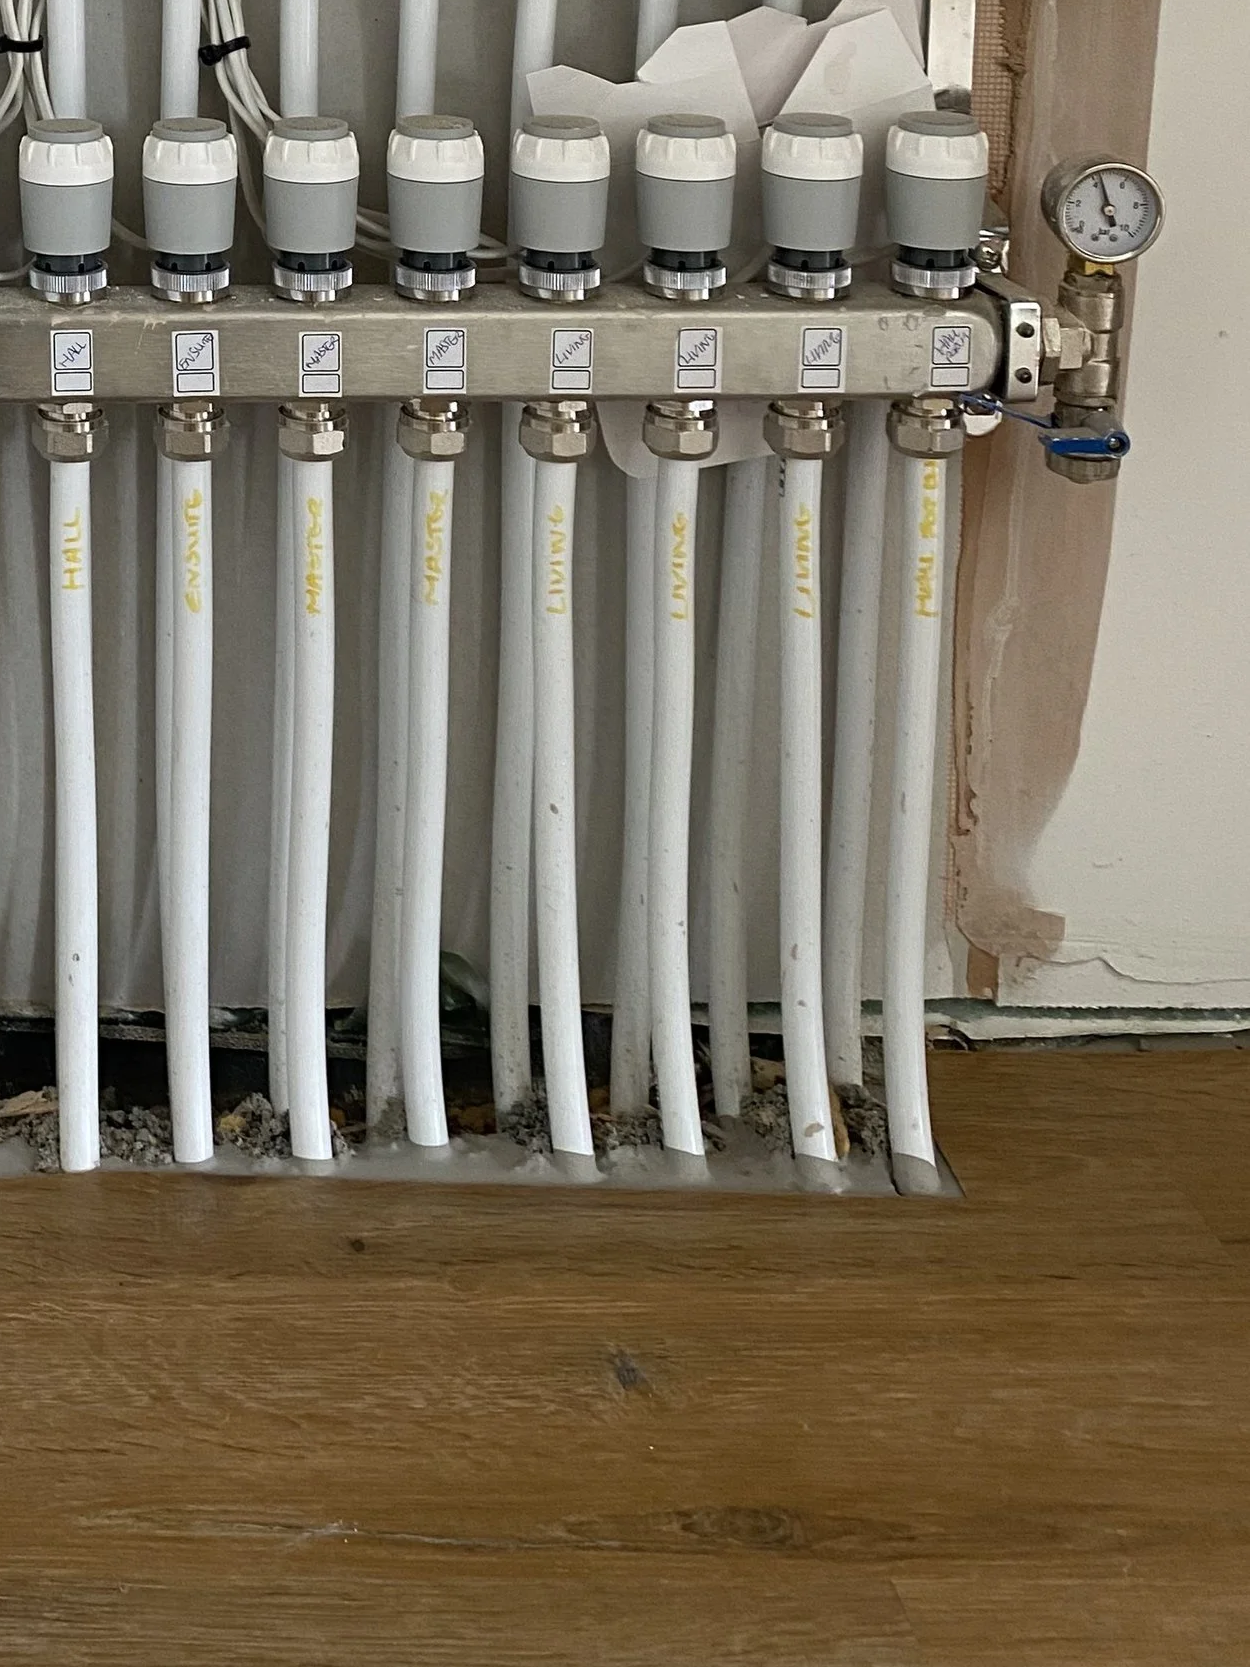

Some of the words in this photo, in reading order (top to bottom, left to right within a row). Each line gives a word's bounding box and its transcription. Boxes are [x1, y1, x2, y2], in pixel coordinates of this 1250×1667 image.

[58, 340, 87, 368] HALL
[554, 332, 591, 366] LIVING
[62, 507, 81, 591] HALL
[547, 505, 567, 615] LIVING
